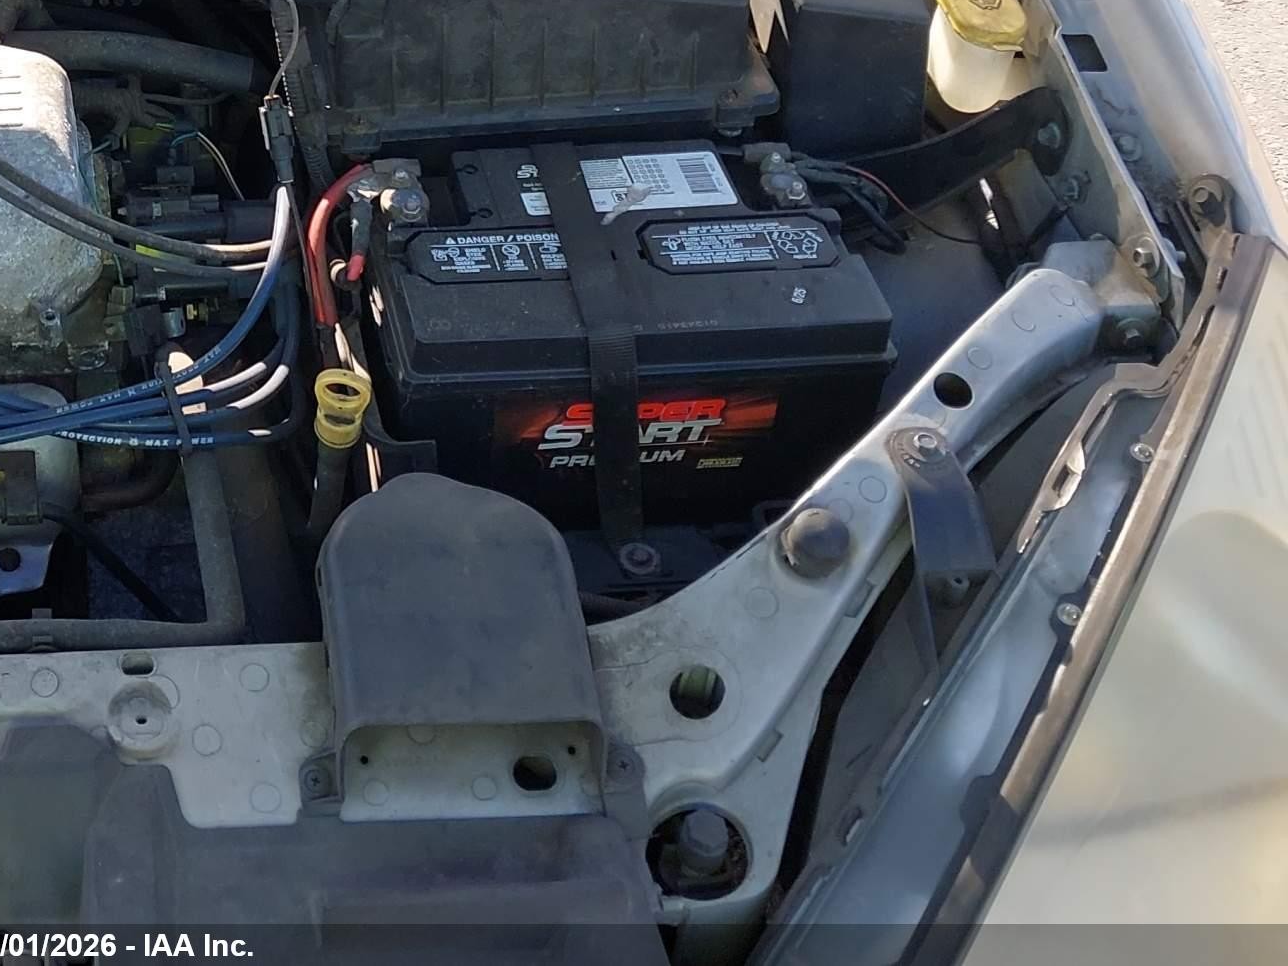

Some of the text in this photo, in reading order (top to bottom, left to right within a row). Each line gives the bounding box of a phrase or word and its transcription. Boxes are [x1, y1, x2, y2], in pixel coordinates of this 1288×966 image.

[457, 235, 505, 244] DANGER
[516, 233, 560, 242] POISON
[562, 399, 726, 425] SPER
[145, 439, 169, 447] MAX
[176, 437, 214, 446] PWER
